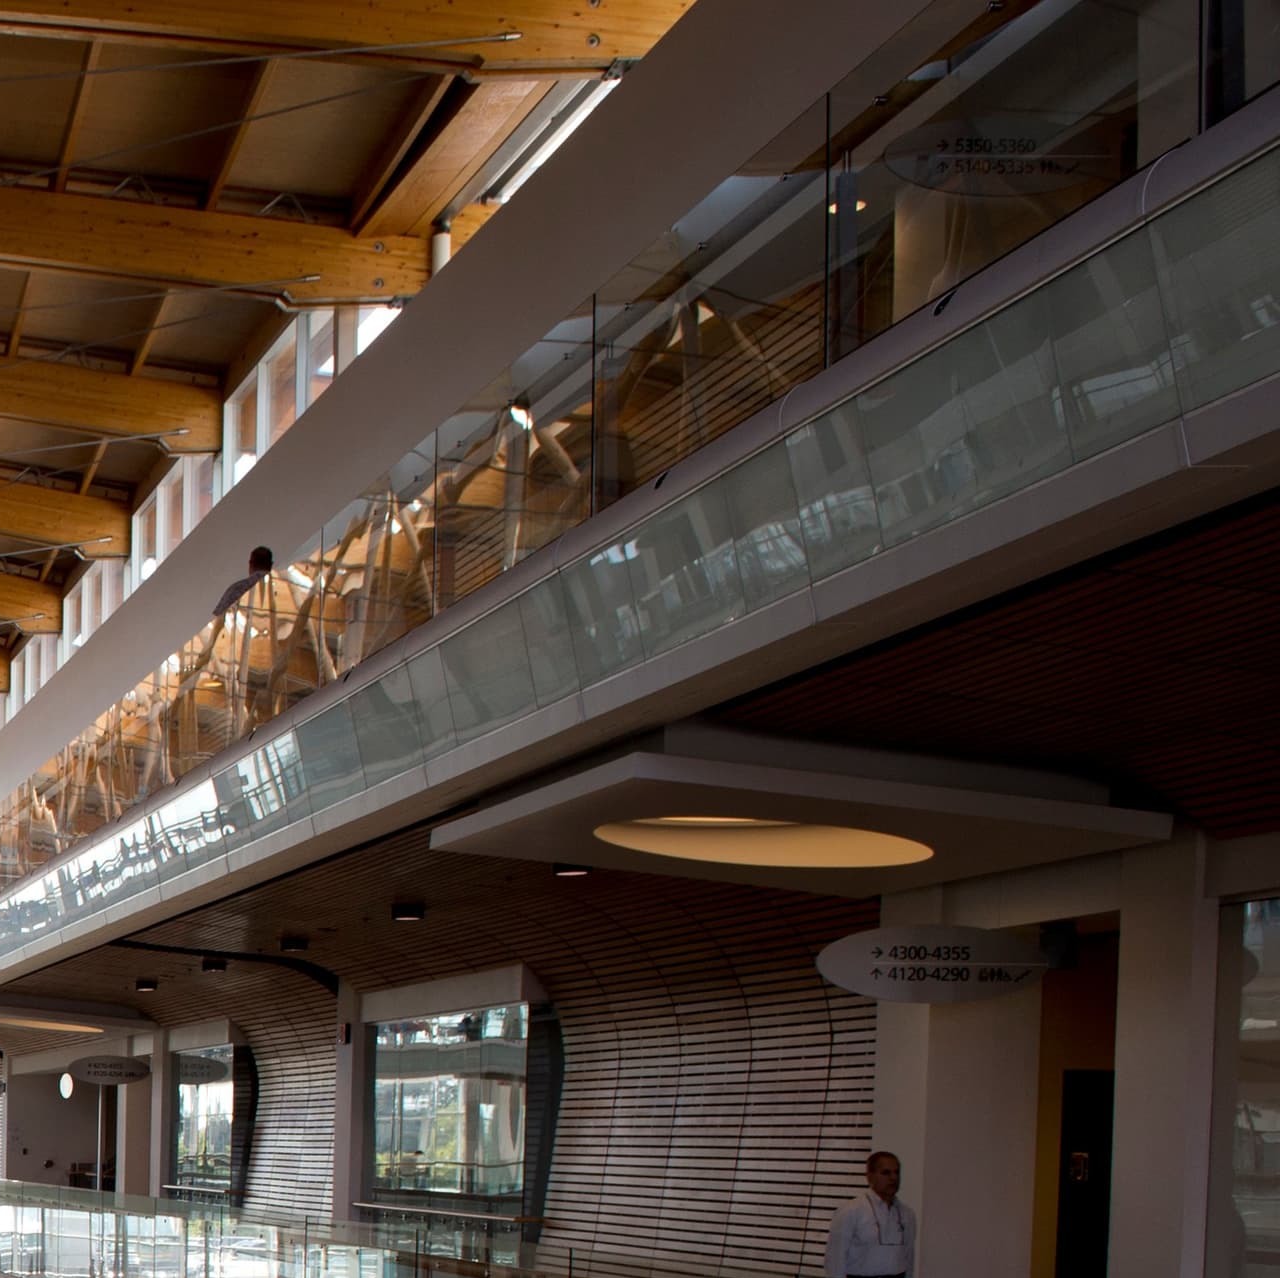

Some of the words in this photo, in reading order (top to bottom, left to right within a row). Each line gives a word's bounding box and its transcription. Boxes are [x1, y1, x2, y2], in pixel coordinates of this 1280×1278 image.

[955, 138, 1036, 153] 5350-5360
[955, 160, 1034, 174] 5140-5335
[889, 946, 970, 960] 4300-4355
[887, 967, 970, 981] 4120-4290
